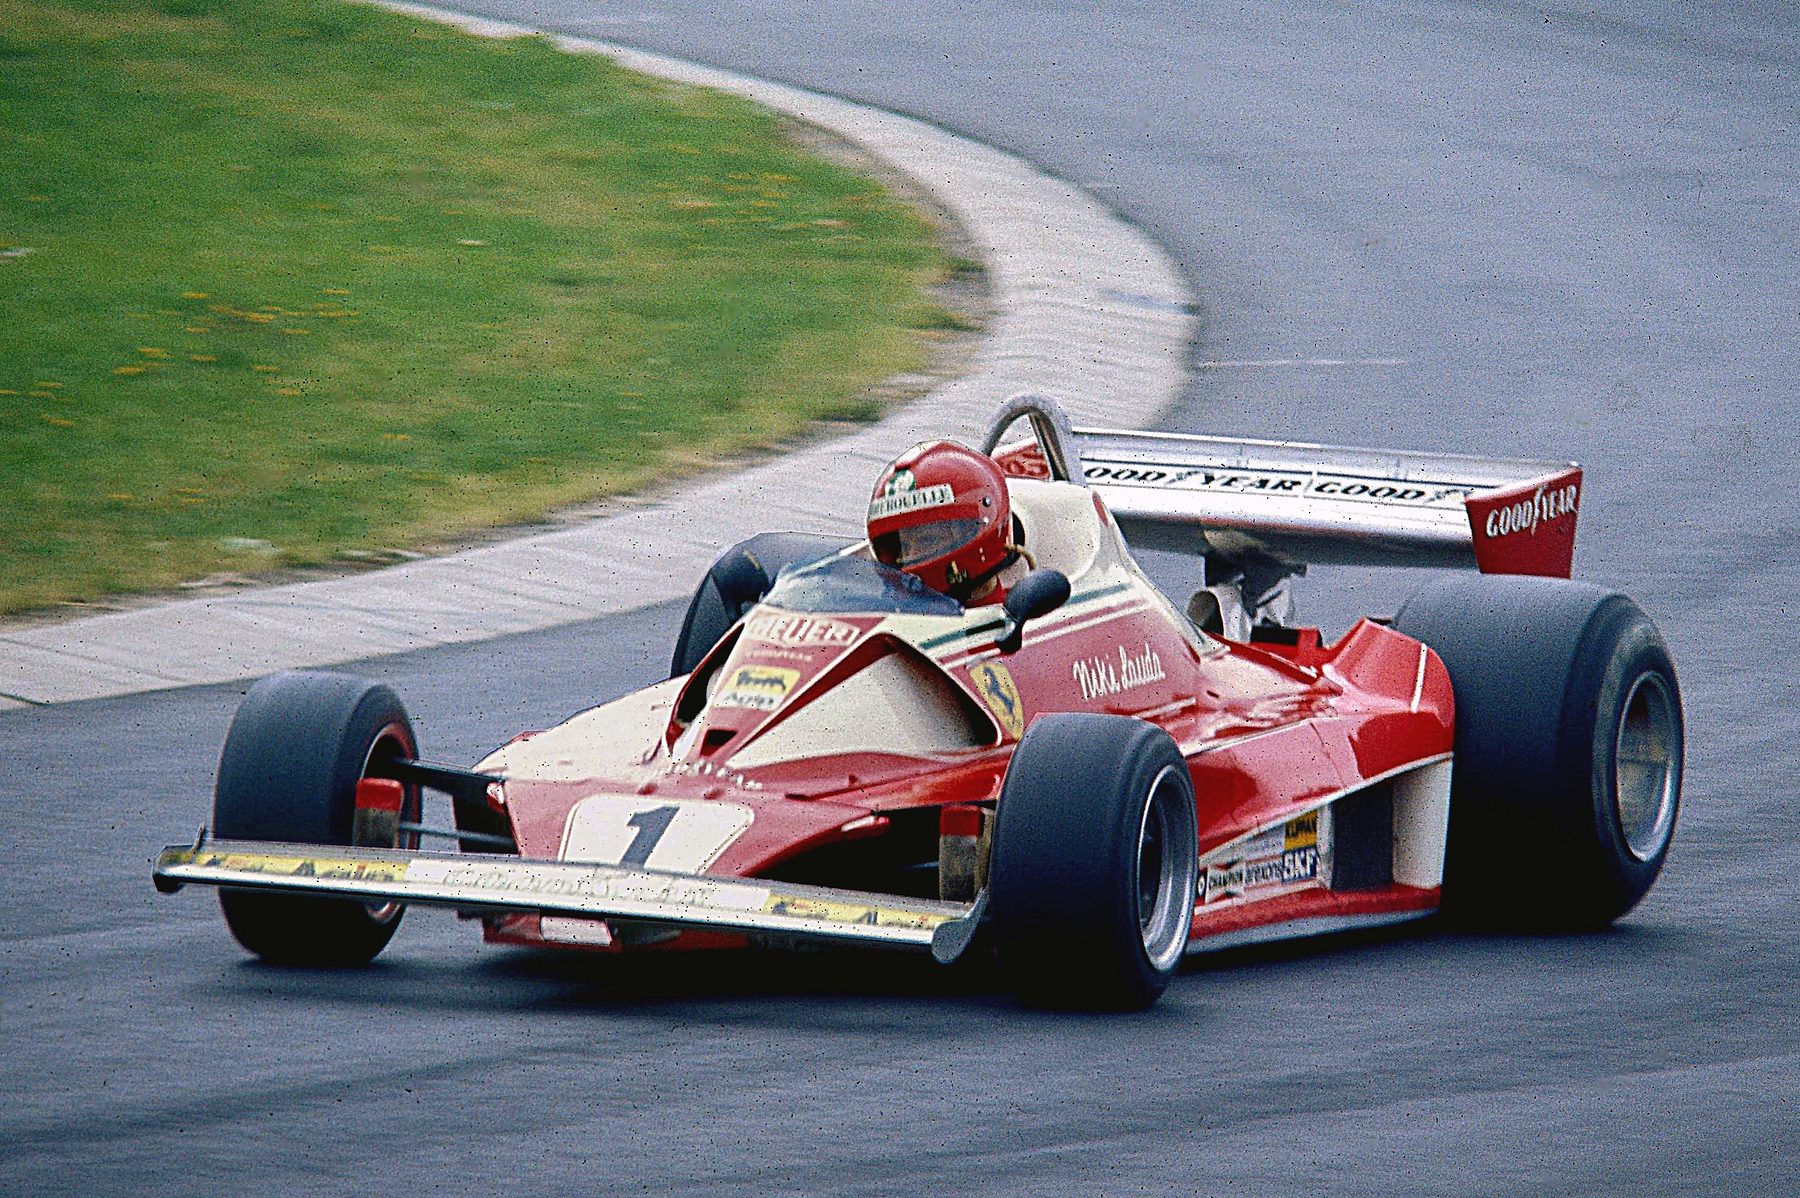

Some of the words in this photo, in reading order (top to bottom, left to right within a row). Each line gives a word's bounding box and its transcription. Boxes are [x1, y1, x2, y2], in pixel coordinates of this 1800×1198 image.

[1072, 653, 1120, 701] Niki
[1119, 642, 1166, 690] Lauda
[620, 806, 681, 865] 1
[1283, 848, 1318, 880] SKF
